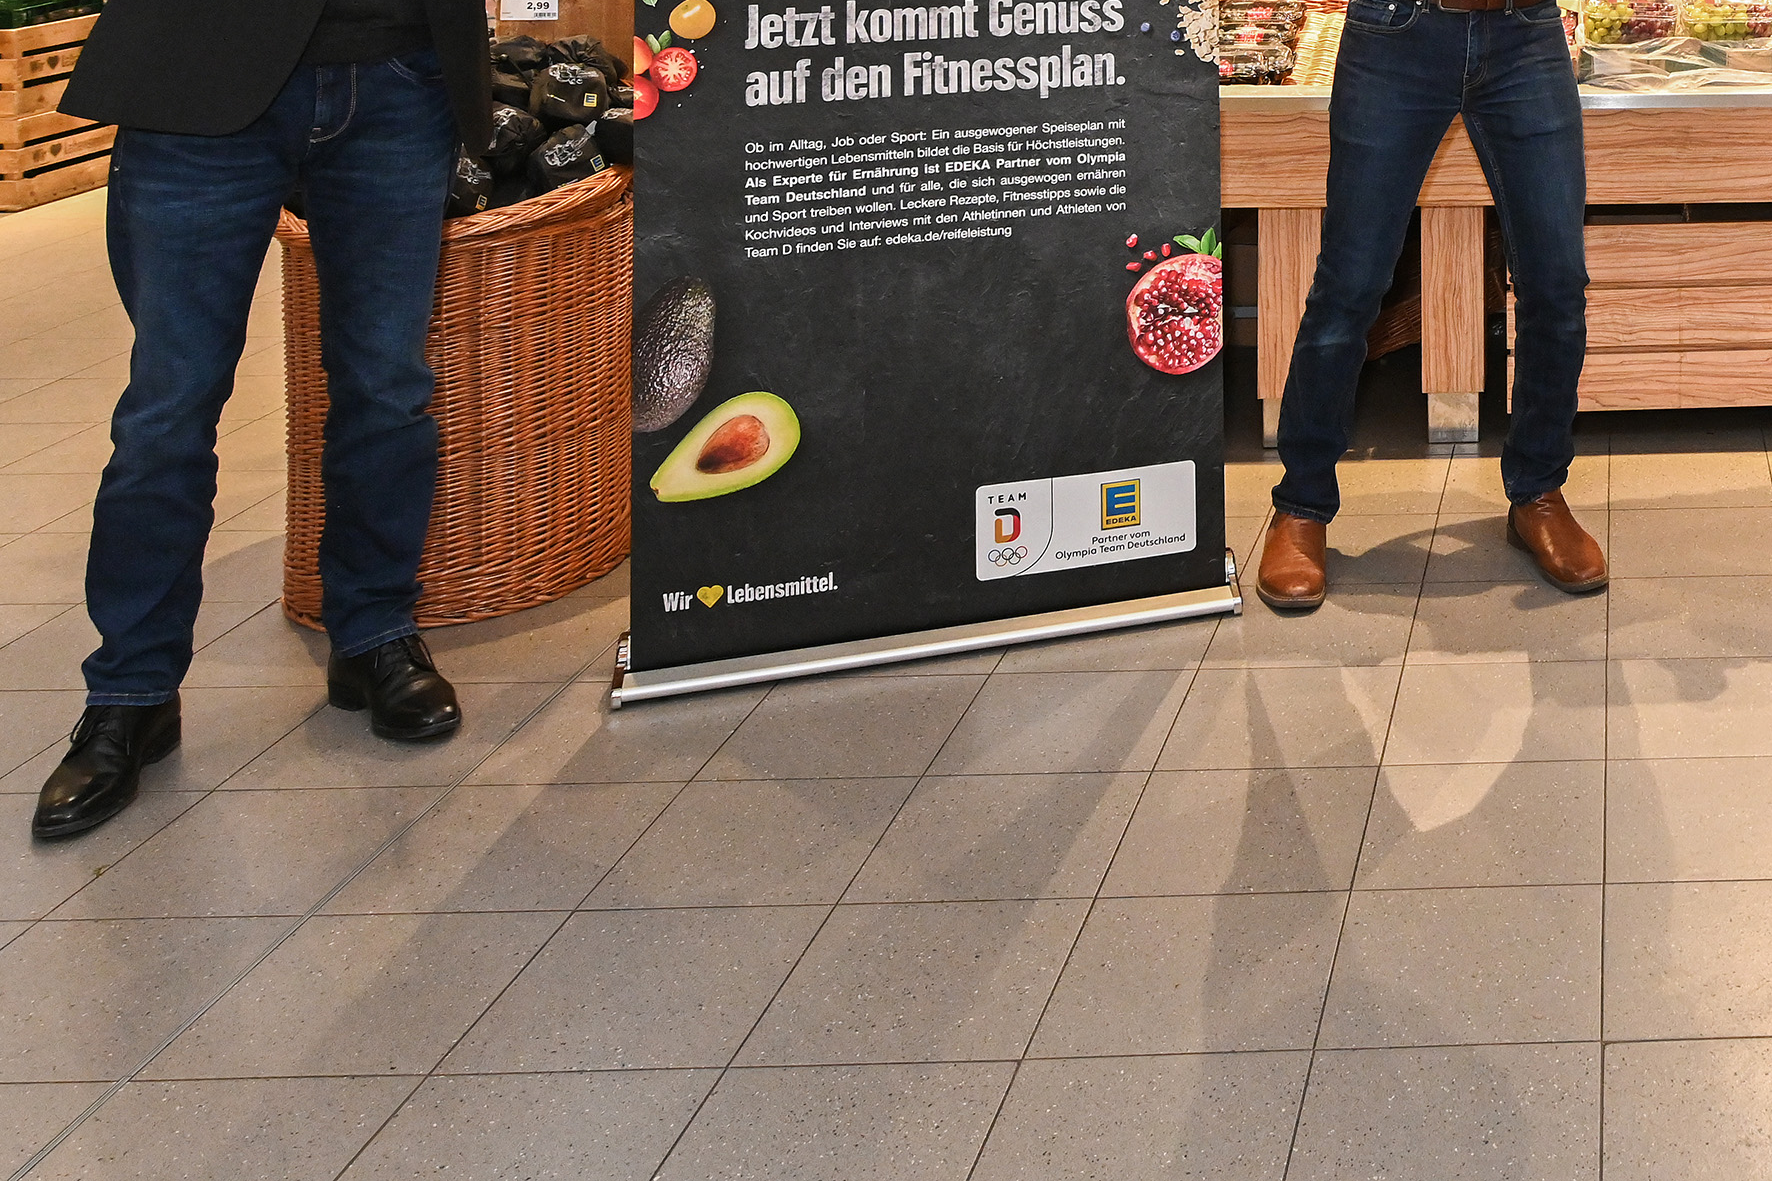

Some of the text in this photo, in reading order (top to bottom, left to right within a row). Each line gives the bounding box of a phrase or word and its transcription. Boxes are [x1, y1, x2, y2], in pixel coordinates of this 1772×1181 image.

[527, 2, 549, 11] 2,99
[744, 5, 836, 49] Jetzt
[846, 0, 978, 44] kommt
[745, 45, 1126, 106] auf den Fitnessplan.
[745, 119, 1126, 154] Ob im Alltag, Job oder Sport: Ein ausgewogener Speiseplan mit
[745, 137, 1125, 170] hochwertigen Lebensmitteln bildet die Basis für Höchstleistungen.
[745, 152, 1126, 188] Als Experte für Ernährung ist EDEKA Partner vom Olympia
[745, 225, 1012, 258] Team D finden Sie auf: edeka.de/reifeleistung
[988, 493, 1027, 504] TEAM
[1106, 515, 1137, 525] EDEKA
[1055, 534, 1186, 560] Olympia Team Deutschland
[1092, 530, 1150, 545] Partner vom
[663, 572, 838, 612] Wir Lebensmittel.
